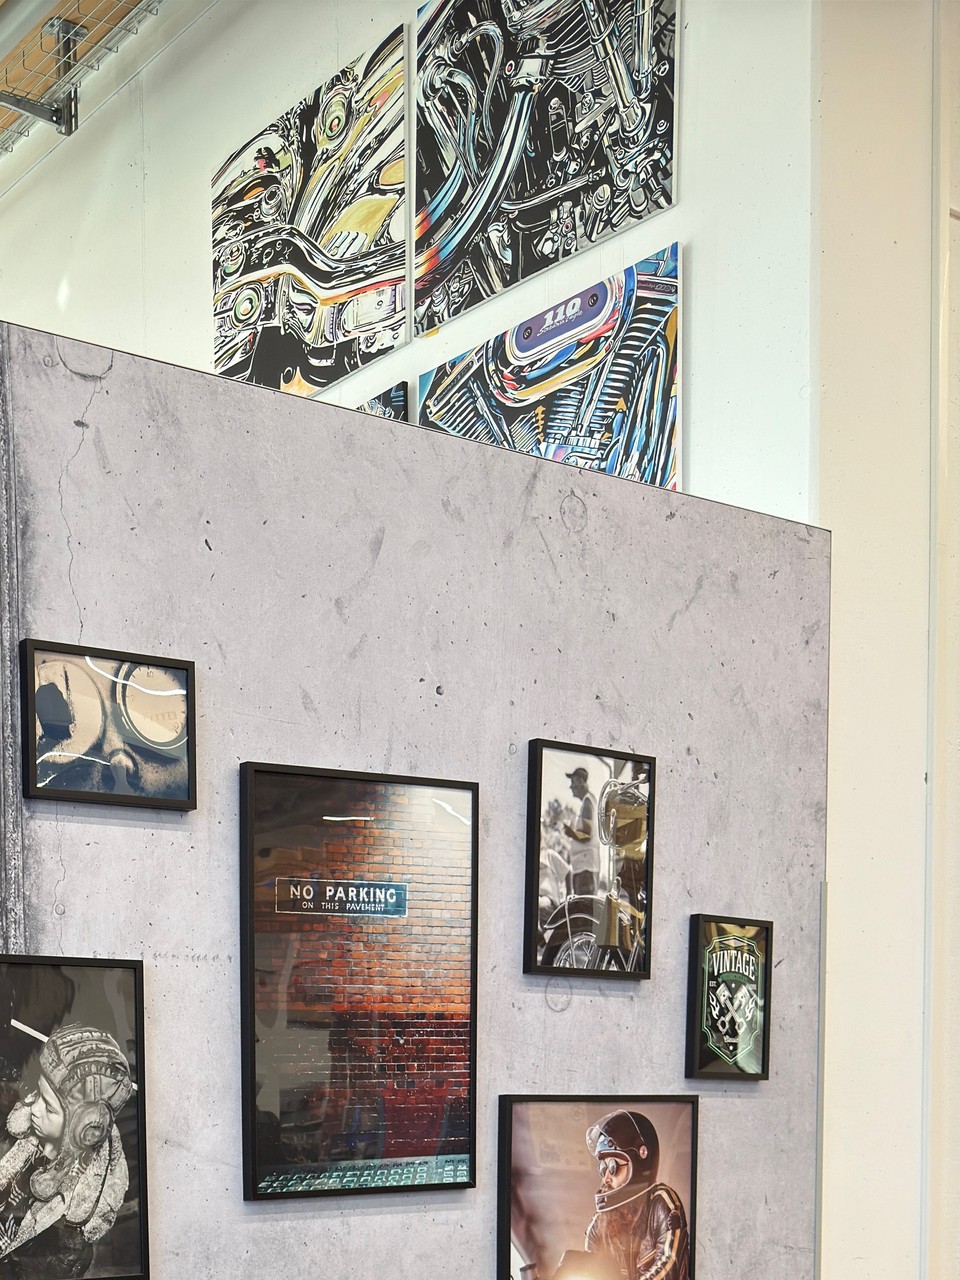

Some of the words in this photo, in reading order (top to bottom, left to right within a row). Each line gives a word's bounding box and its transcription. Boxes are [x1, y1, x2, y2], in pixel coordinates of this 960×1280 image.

[543, 297, 581, 328] 110
[290, 884, 314, 899] NO
[326, 886, 396, 902] PARKING
[302, 901, 314, 909] ON
[321, 902, 339, 910] THIS
[346, 902, 385, 912] PAVEMENT
[712, 949, 756, 982] VINTAGE
